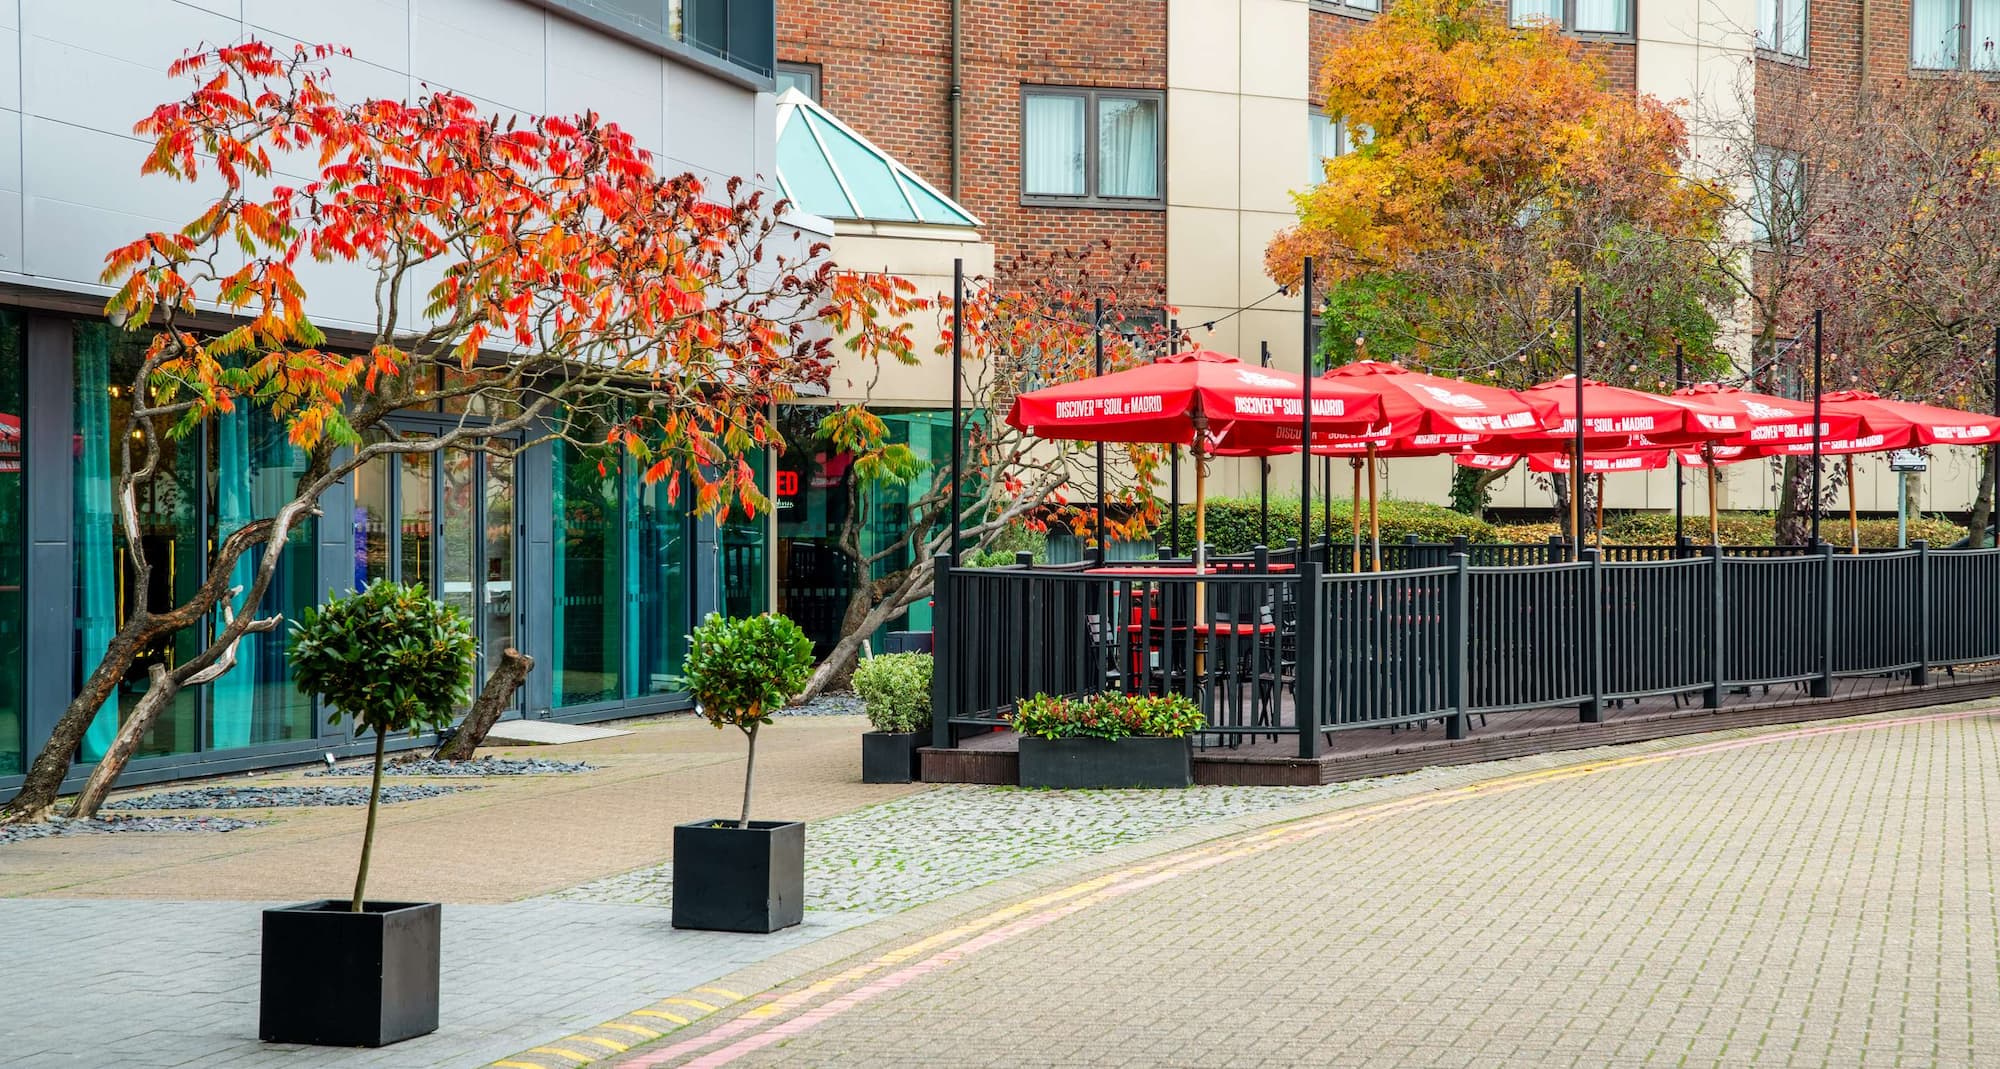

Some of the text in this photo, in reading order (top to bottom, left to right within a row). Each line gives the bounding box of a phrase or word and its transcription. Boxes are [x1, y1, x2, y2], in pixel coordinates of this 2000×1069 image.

[1056, 400, 1094, 418] DISCOVER
[1095, 399, 1104, 408] THE
[1104, 398, 1123, 415] SOUL
[1131, 395, 1162, 413] MADRID
[1234, 396, 1274, 414] DISCOVER
[1283, 398, 1304, 416] SOUL
[1311, 399, 1344, 416] MADRID
[1594, 418, 1614, 432] SOUL
[1622, 416, 1654, 431] MADRID
